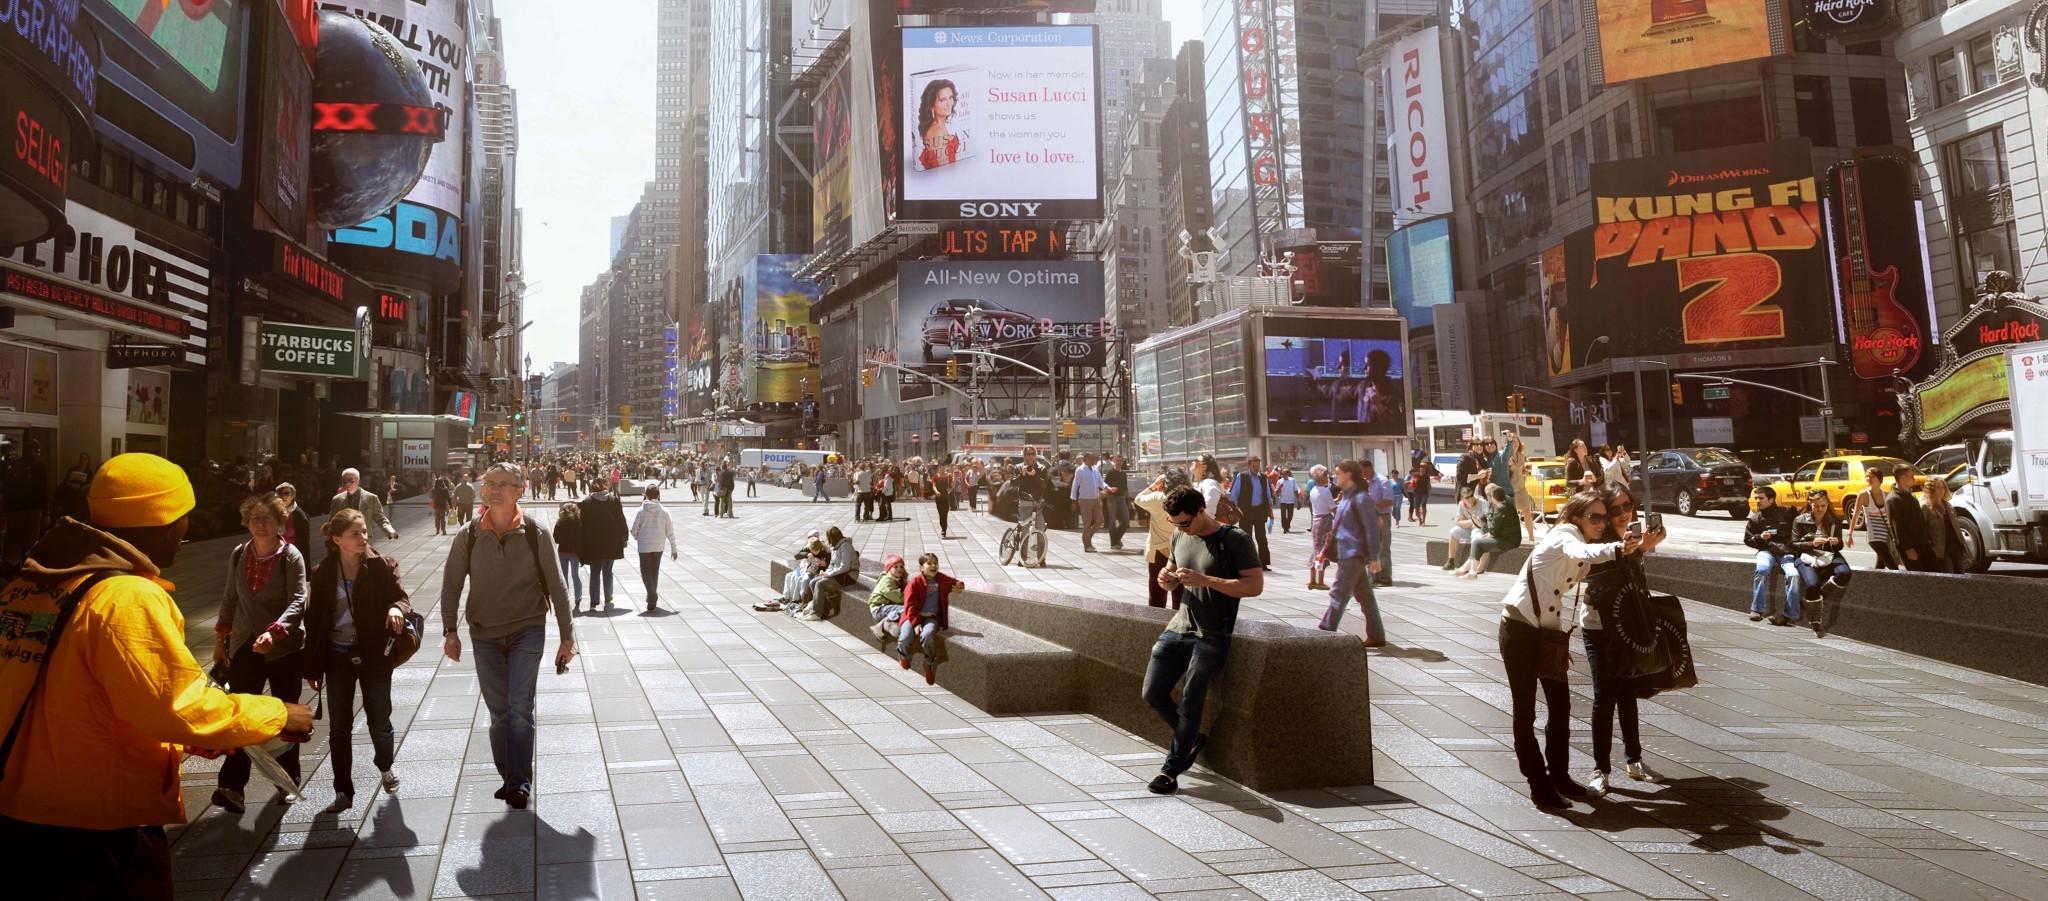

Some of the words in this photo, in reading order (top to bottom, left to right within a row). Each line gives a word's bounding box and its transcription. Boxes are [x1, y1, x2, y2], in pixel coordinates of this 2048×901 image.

[1814, 0, 1843, 13] Hard
[1838, 10, 1854, 18] CAFE
[950, 32, 982, 43] News
[987, 31, 1062, 45] Corporation
[1671, 37, 1686, 45] MAY
[427, 29, 461, 70] YOU
[1025, 70, 1045, 79] her
[988, 86, 1038, 103] Susan
[1042, 86, 1087, 102] Lucci
[1242, 0, 1276, 186] OUNG
[988, 111, 1022, 121] shows
[1023, 112, 1037, 121] us
[1402, 47, 1431, 205] RICOH
[989, 130, 1006, 139] the
[1008, 131, 1046, 139] woman
[1046, 131, 1066, 141] you
[990, 148, 1021, 164] love
[1025, 150, 1039, 164] to
[959, 202, 1042, 218] SONY
[1596, 187, 1755, 224] KUNG
[327, 201, 461, 268] SDA
[999, 229, 1038, 253] TAP
[1590, 202, 1822, 289] PAND
[0, 222, 171, 306] EPHORA
[284, 244, 299, 280] Find
[924, 269, 1001, 285] All-New
[1007, 269, 1080, 287] Optima
[1676, 252, 1785, 345] 2
[382, 294, 404, 321] Find
[991, 317, 1036, 338] YORK
[1040, 317, 1094, 338] POLICE
[1979, 321, 2009, 344] Hard
[2010, 317, 2040, 344] Rock
[261, 333, 353, 353] STARBUCKS
[1855, 335, 1886, 350] Hard
[1887, 333, 1918, 350] Rock
[116, 349, 177, 358] SEPHORA
[274, 349, 336, 366] COFFEE
[727, 425, 759, 436] LOFT
[404, 455, 430, 466] Drink
